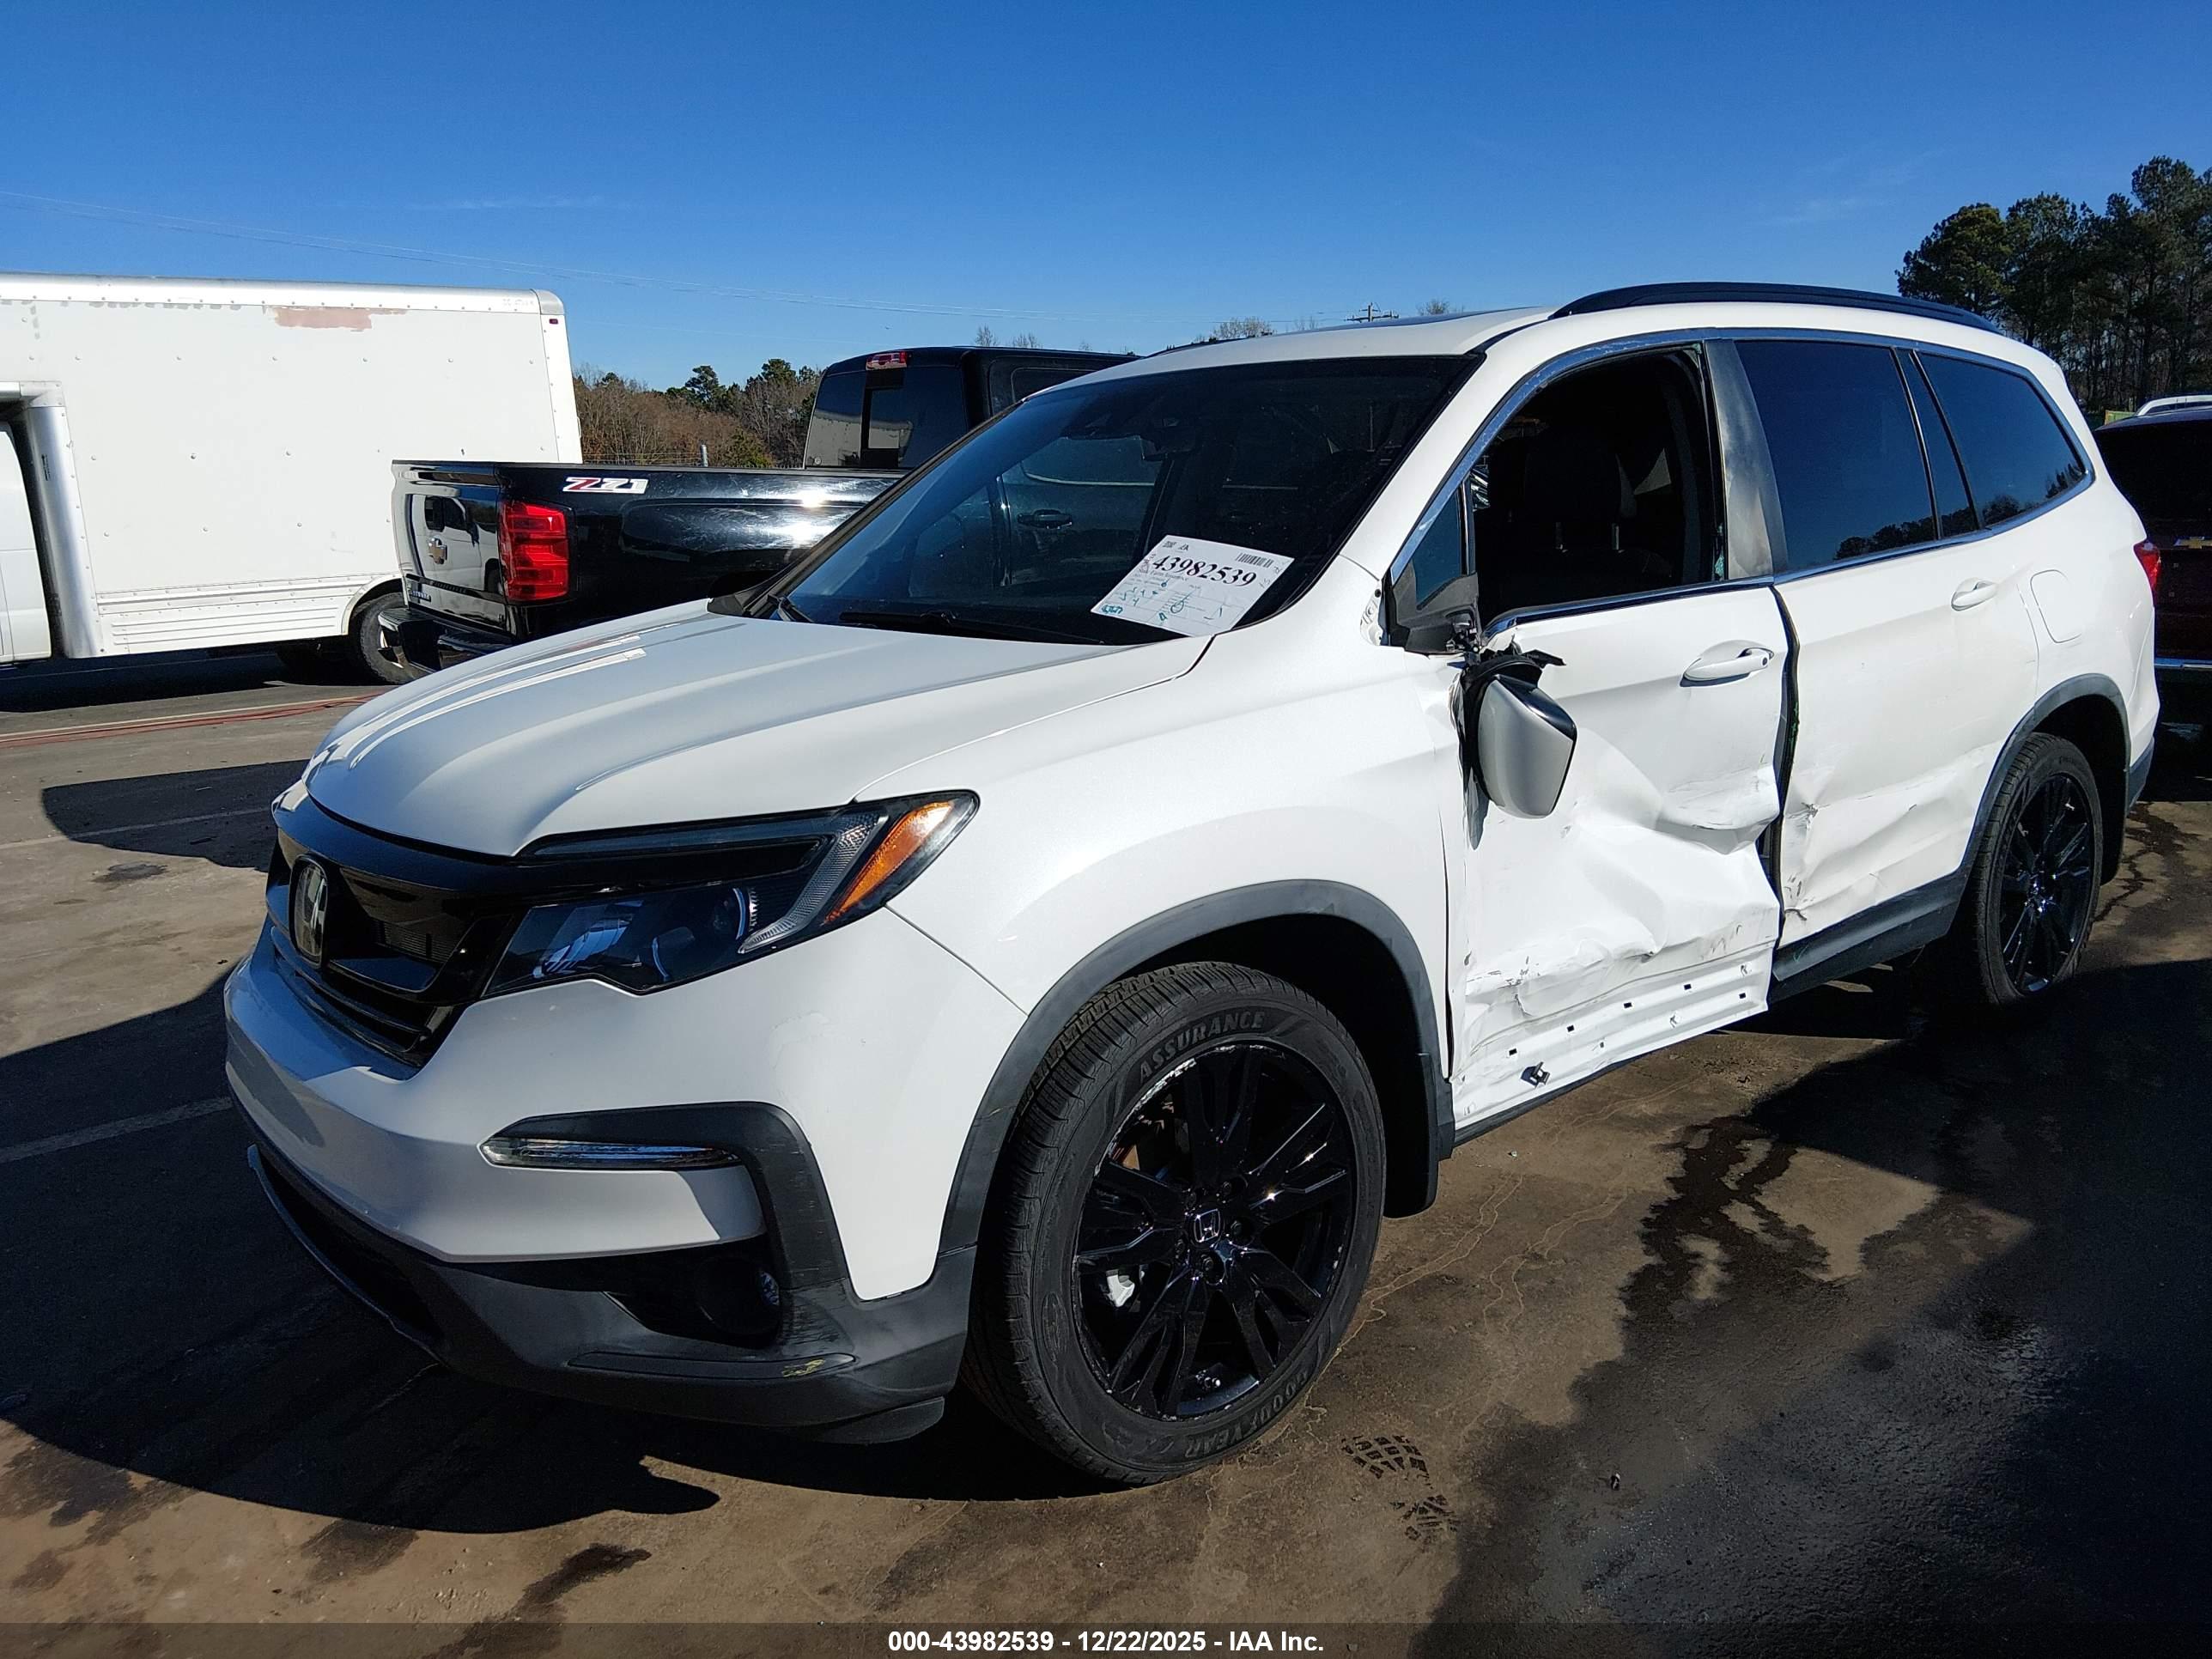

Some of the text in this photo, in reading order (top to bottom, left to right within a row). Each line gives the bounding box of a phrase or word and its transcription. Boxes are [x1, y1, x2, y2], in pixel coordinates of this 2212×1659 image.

[562, 477, 648, 494] Z71
[1152, 556, 1257, 586] 43982539
[1139, 1011, 1265, 1084] ASSURANCE
